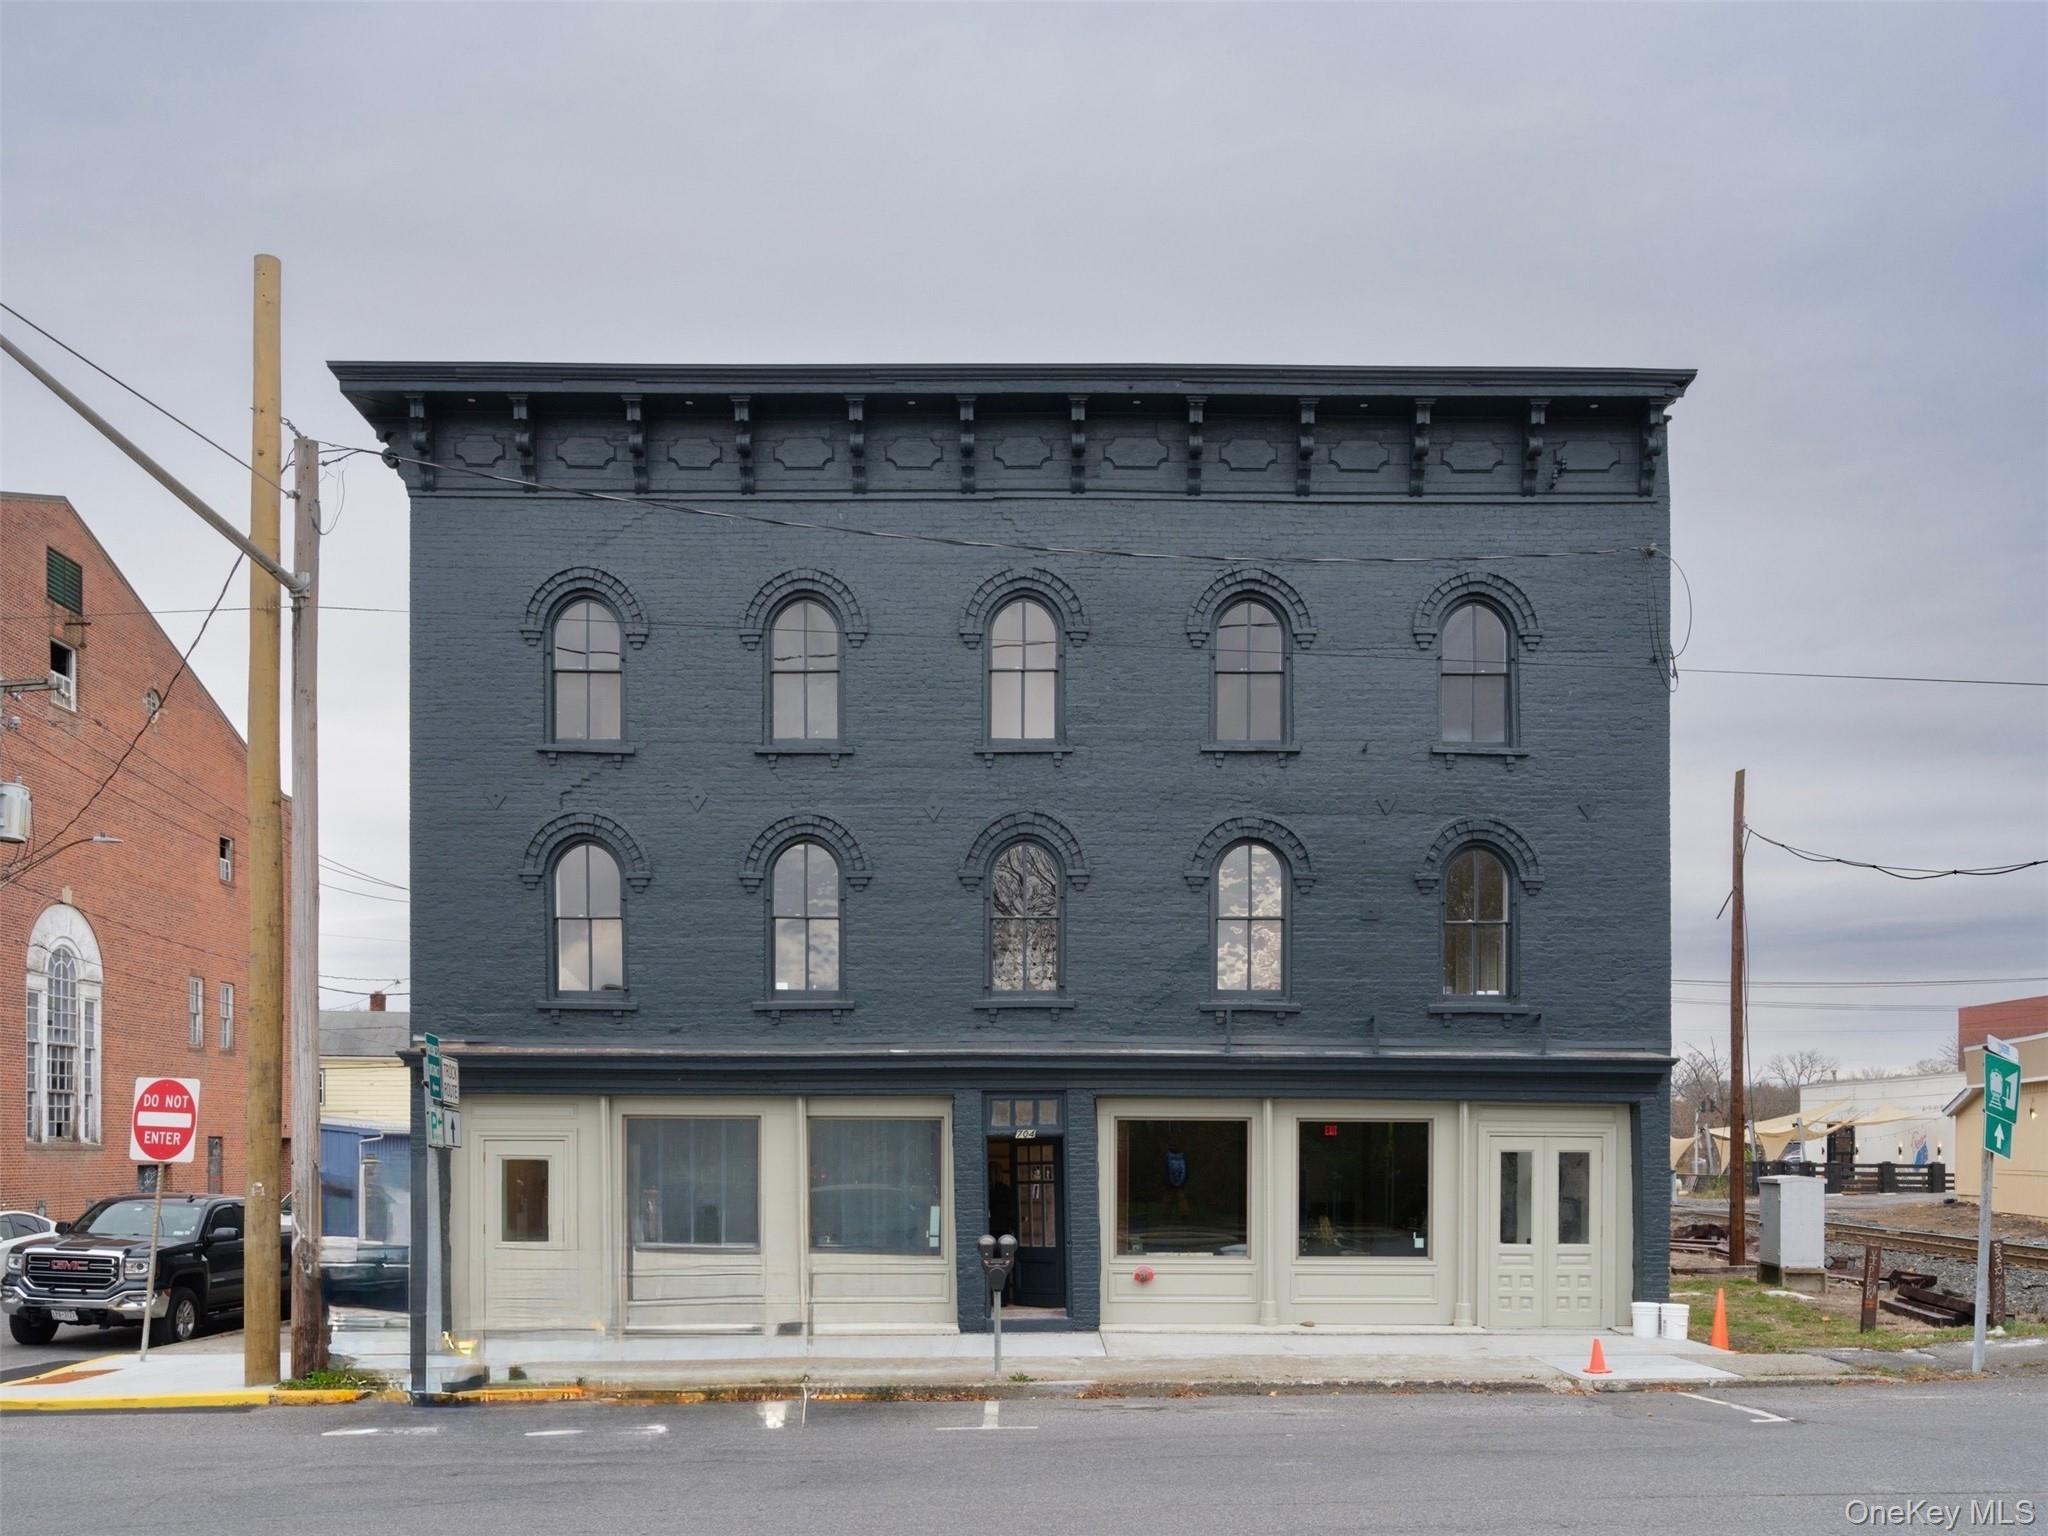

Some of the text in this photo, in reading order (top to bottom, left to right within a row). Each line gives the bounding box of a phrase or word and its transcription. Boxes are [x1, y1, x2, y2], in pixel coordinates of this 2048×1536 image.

[443, 1063, 458, 1080] TRUCK
[444, 1081, 459, 1099] ROUTE
[143, 1094, 190, 1109] DO NOT
[144, 1130, 182, 1146] ENTER
[1016, 1130, 1035, 1138] 704
[50, 1259, 89, 1271] GMC
